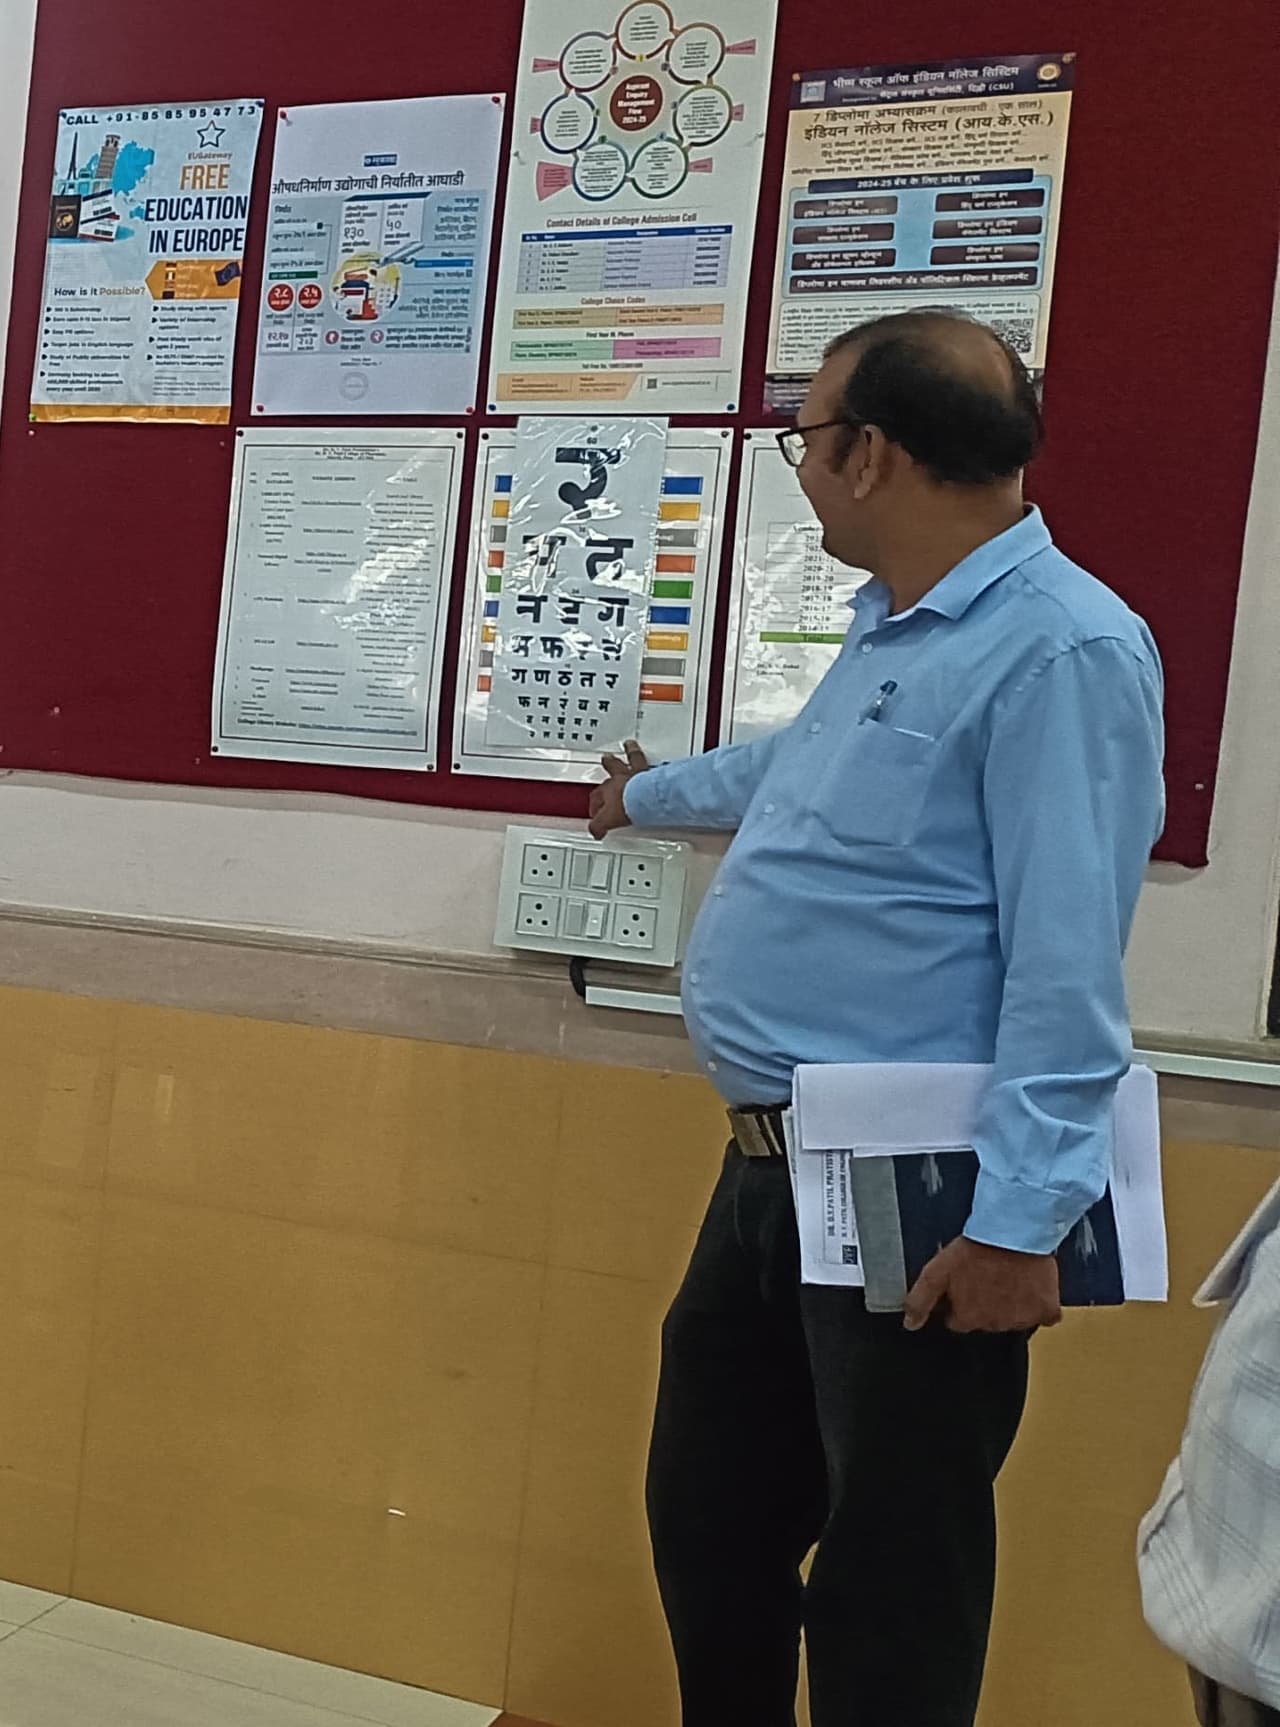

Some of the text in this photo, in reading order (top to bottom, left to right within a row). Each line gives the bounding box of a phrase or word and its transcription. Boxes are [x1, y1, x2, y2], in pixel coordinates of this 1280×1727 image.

[66, 115, 99, 125] CALL
[238, 106, 255, 115] 73
[804, 125, 848, 140] इंडियन
[854, 121, 896, 135] नॉलेज
[902, 119, 948, 133] सिस्टम
[180, 164, 231, 190] FREE
[426, 170, 465, 187] आघाडी
[143, 196, 248, 221] EDUCATION
[641, 214, 680, 223] Admission
[149, 228, 245, 253] IN EUROPE
[54, 288, 76, 296] How
[91, 288, 98, 296] it
[100, 287, 145, 296] Possible?
[585, 538, 634, 581] त
[516, 595, 629, 627] न ग
[540, 637, 564, 658] फ
[512, 669, 619, 688] ग ण ठ त र
[538, 697, 550, 708] न
